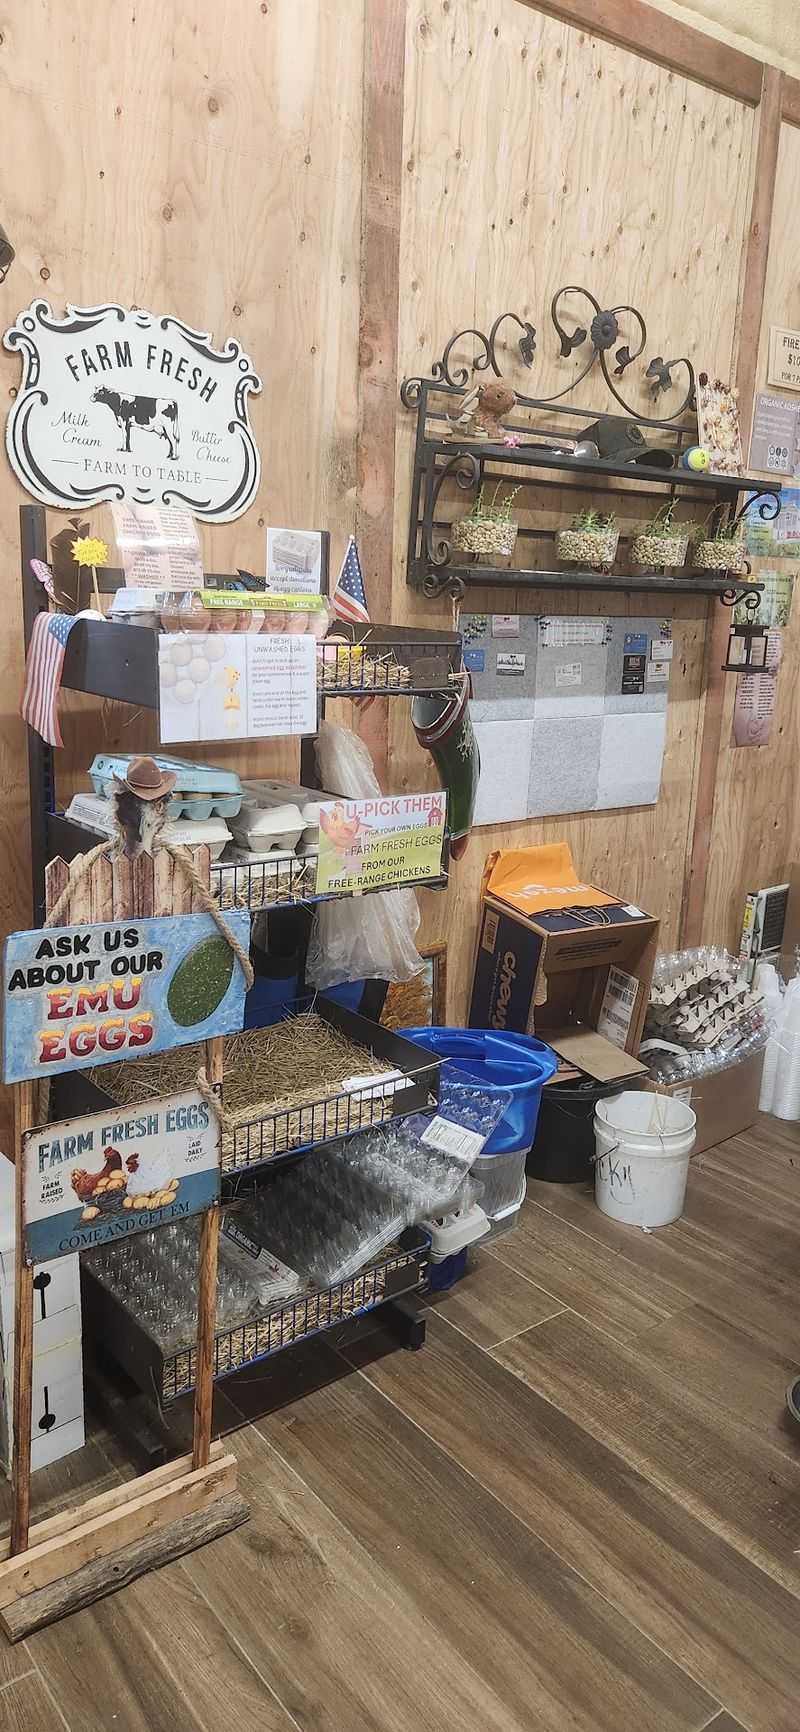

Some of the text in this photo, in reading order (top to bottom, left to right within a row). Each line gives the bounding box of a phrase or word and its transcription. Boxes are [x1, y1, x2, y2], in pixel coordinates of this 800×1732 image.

[65, 341, 217, 402] FARM FRESH
[51, 410, 90, 428] Milk
[62, 429, 103, 448] Cream
[191, 429, 223, 446] Butter
[196, 446, 231, 464] Cheese
[83, 459, 202, 484] FARM TO TABLE
[254, 646, 289, 654] UNWASHED
[270, 637, 290, 645] FRESH
[346, 796, 442, 819] U-PICK THEM
[364, 822, 428, 837] PICK YOUR OWN EGGS
[351, 834, 442, 856] FARM FRESH EGGS
[362, 856, 405, 871] FROM OUR
[387, 865, 431, 880] CHICKENS
[35, 928, 140, 960] ASK US
[8, 951, 164, 991] ABOUT OUR
[46, 976, 143, 1020] EMU
[39, 1011, 154, 1064] EGGS
[38, 1101, 209, 1173] FARM FRESH EGGS
[188, 1140, 201, 1149] LAID
[187, 1147, 203, 1157] DAILY
[40, 1187, 63, 1199] RAISED
[42, 1180, 60, 1191] FARM
[59, 1231, 102, 1252] COME
[104, 1219, 135, 1238] AND
[139, 1210, 166, 1226] GET
